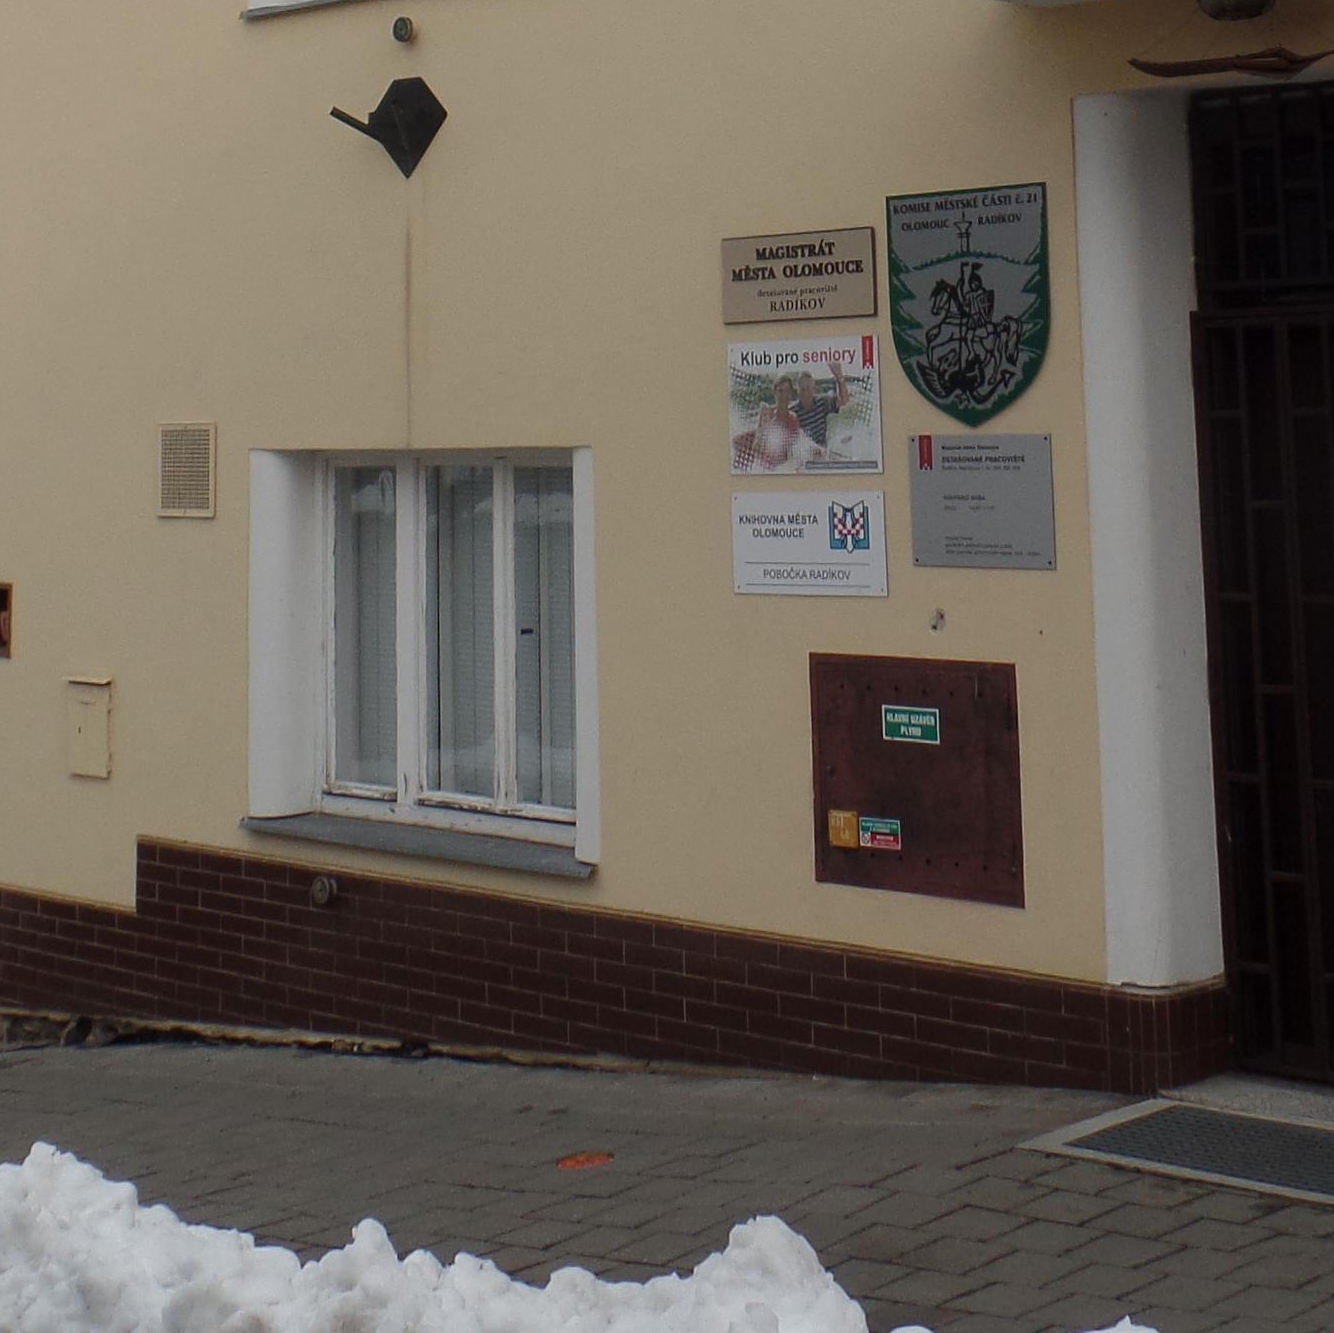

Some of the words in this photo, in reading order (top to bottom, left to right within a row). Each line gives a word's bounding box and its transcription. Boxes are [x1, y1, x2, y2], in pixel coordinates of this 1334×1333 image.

[893, 203, 931, 215] KOMISE
[934, 197, 979, 211] MĚSTSKÉ
[982, 192, 1012, 207] ČÁSTI
[1026, 192, 1038, 204] 21
[901, 218, 950, 231] OLOMOUC
[977, 212, 1023, 225] RADÍKOV
[755, 239, 835, 261] MAGISTRÁT
[731, 265, 777, 282] MĚSTA
[782, 260, 864, 278] OLOMOUCE
[770, 297, 826, 312] RADÍKOV
[741, 350, 772, 367] Klub
[776, 352, 799, 368] pro
[802, 347, 856, 364] seniory
[739, 515, 785, 525] KNIHOVNA
[787, 513, 819, 525] MĚSTA
[752, 527, 805, 538] OLOMOUCE
[763, 567, 808, 580] POBOČKA
[809, 567, 851, 580] RADÍKOV
